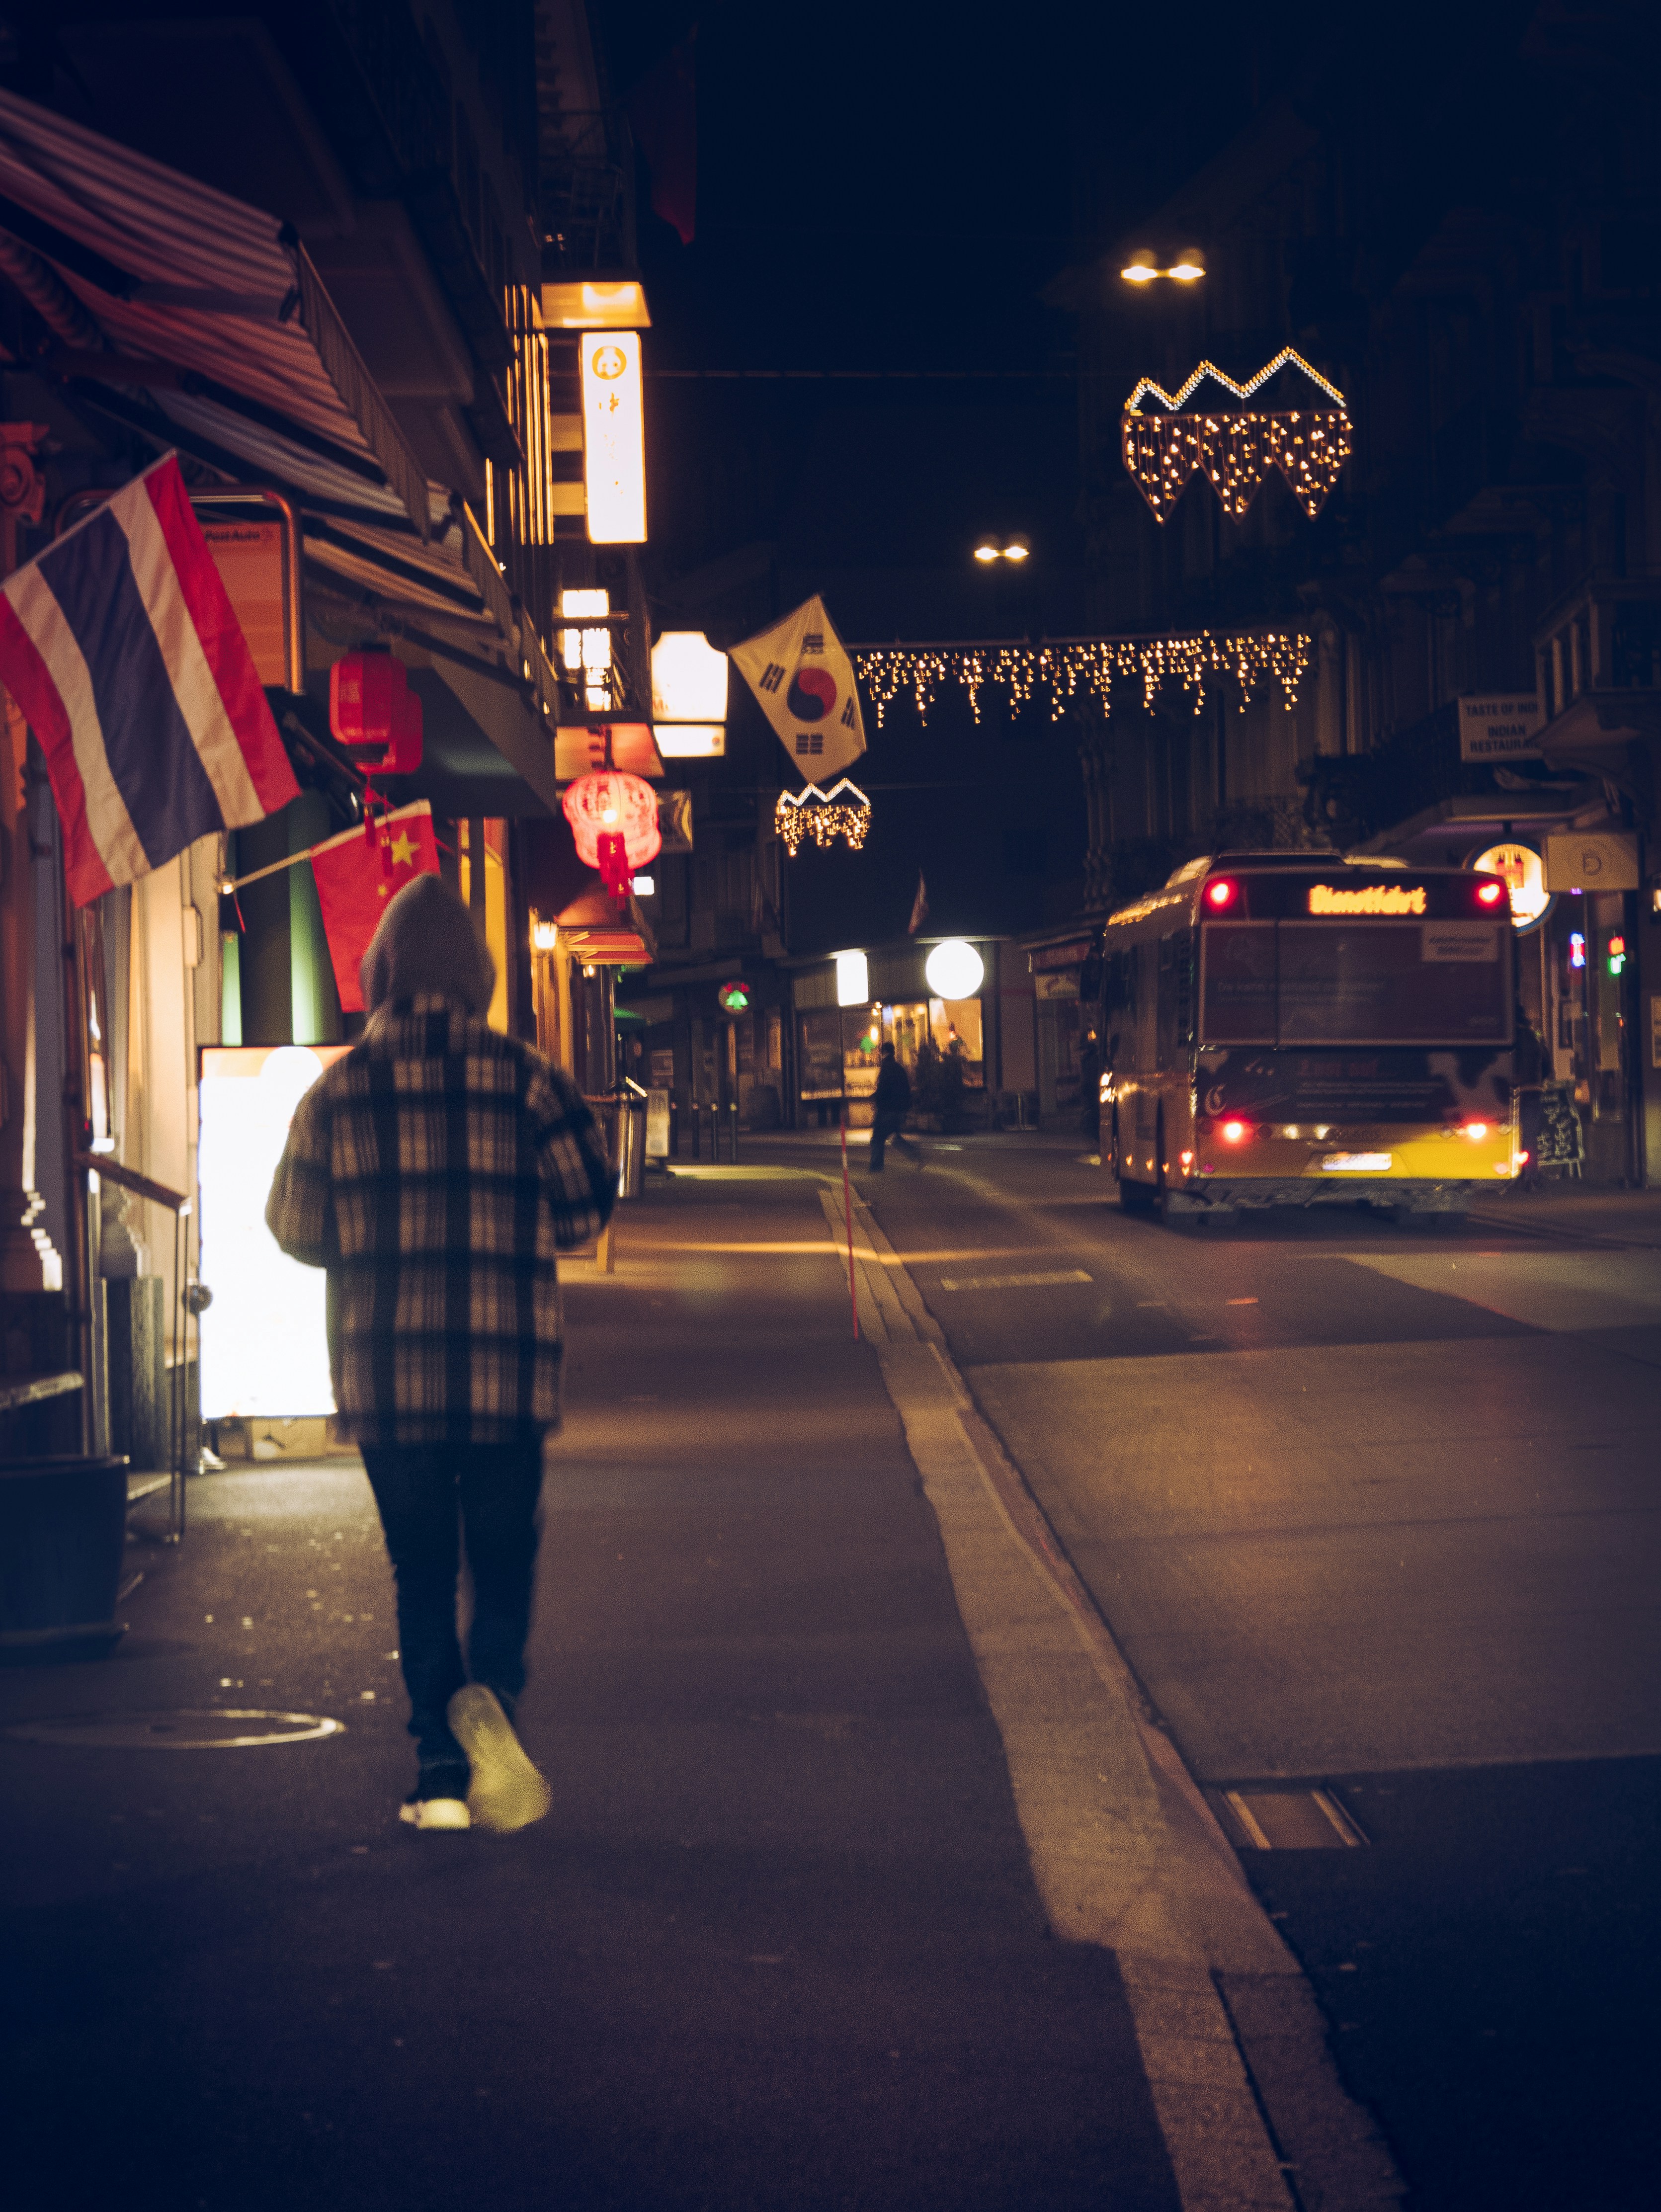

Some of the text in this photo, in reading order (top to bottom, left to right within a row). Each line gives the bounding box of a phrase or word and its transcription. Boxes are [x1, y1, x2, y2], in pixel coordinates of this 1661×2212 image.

[1467, 701, 1538, 717] TASTE OF INDI
[1488, 724, 1526, 737] INDIAN
